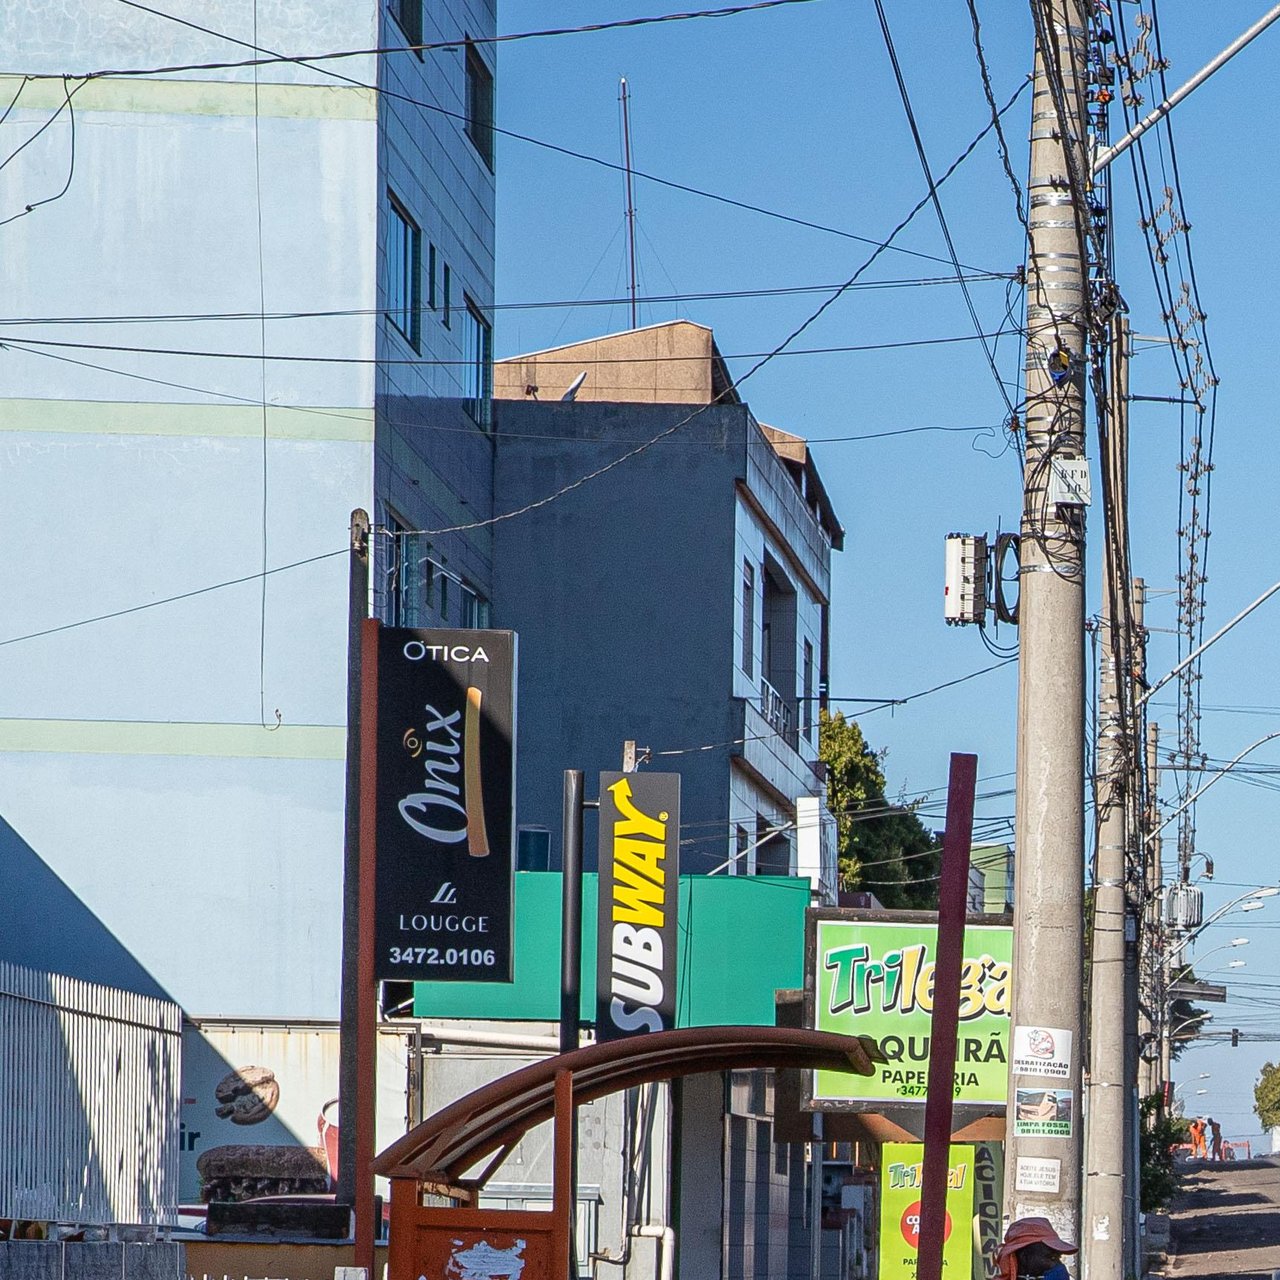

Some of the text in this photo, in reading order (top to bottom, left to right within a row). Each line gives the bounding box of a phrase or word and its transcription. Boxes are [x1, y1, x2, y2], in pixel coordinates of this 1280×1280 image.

[398, 704, 469, 843] Onix
[400, 915, 488, 932] LOUGGE
[609, 778, 667, 1032] SUBWAY
[389, 948, 495, 966] 3472.0106
